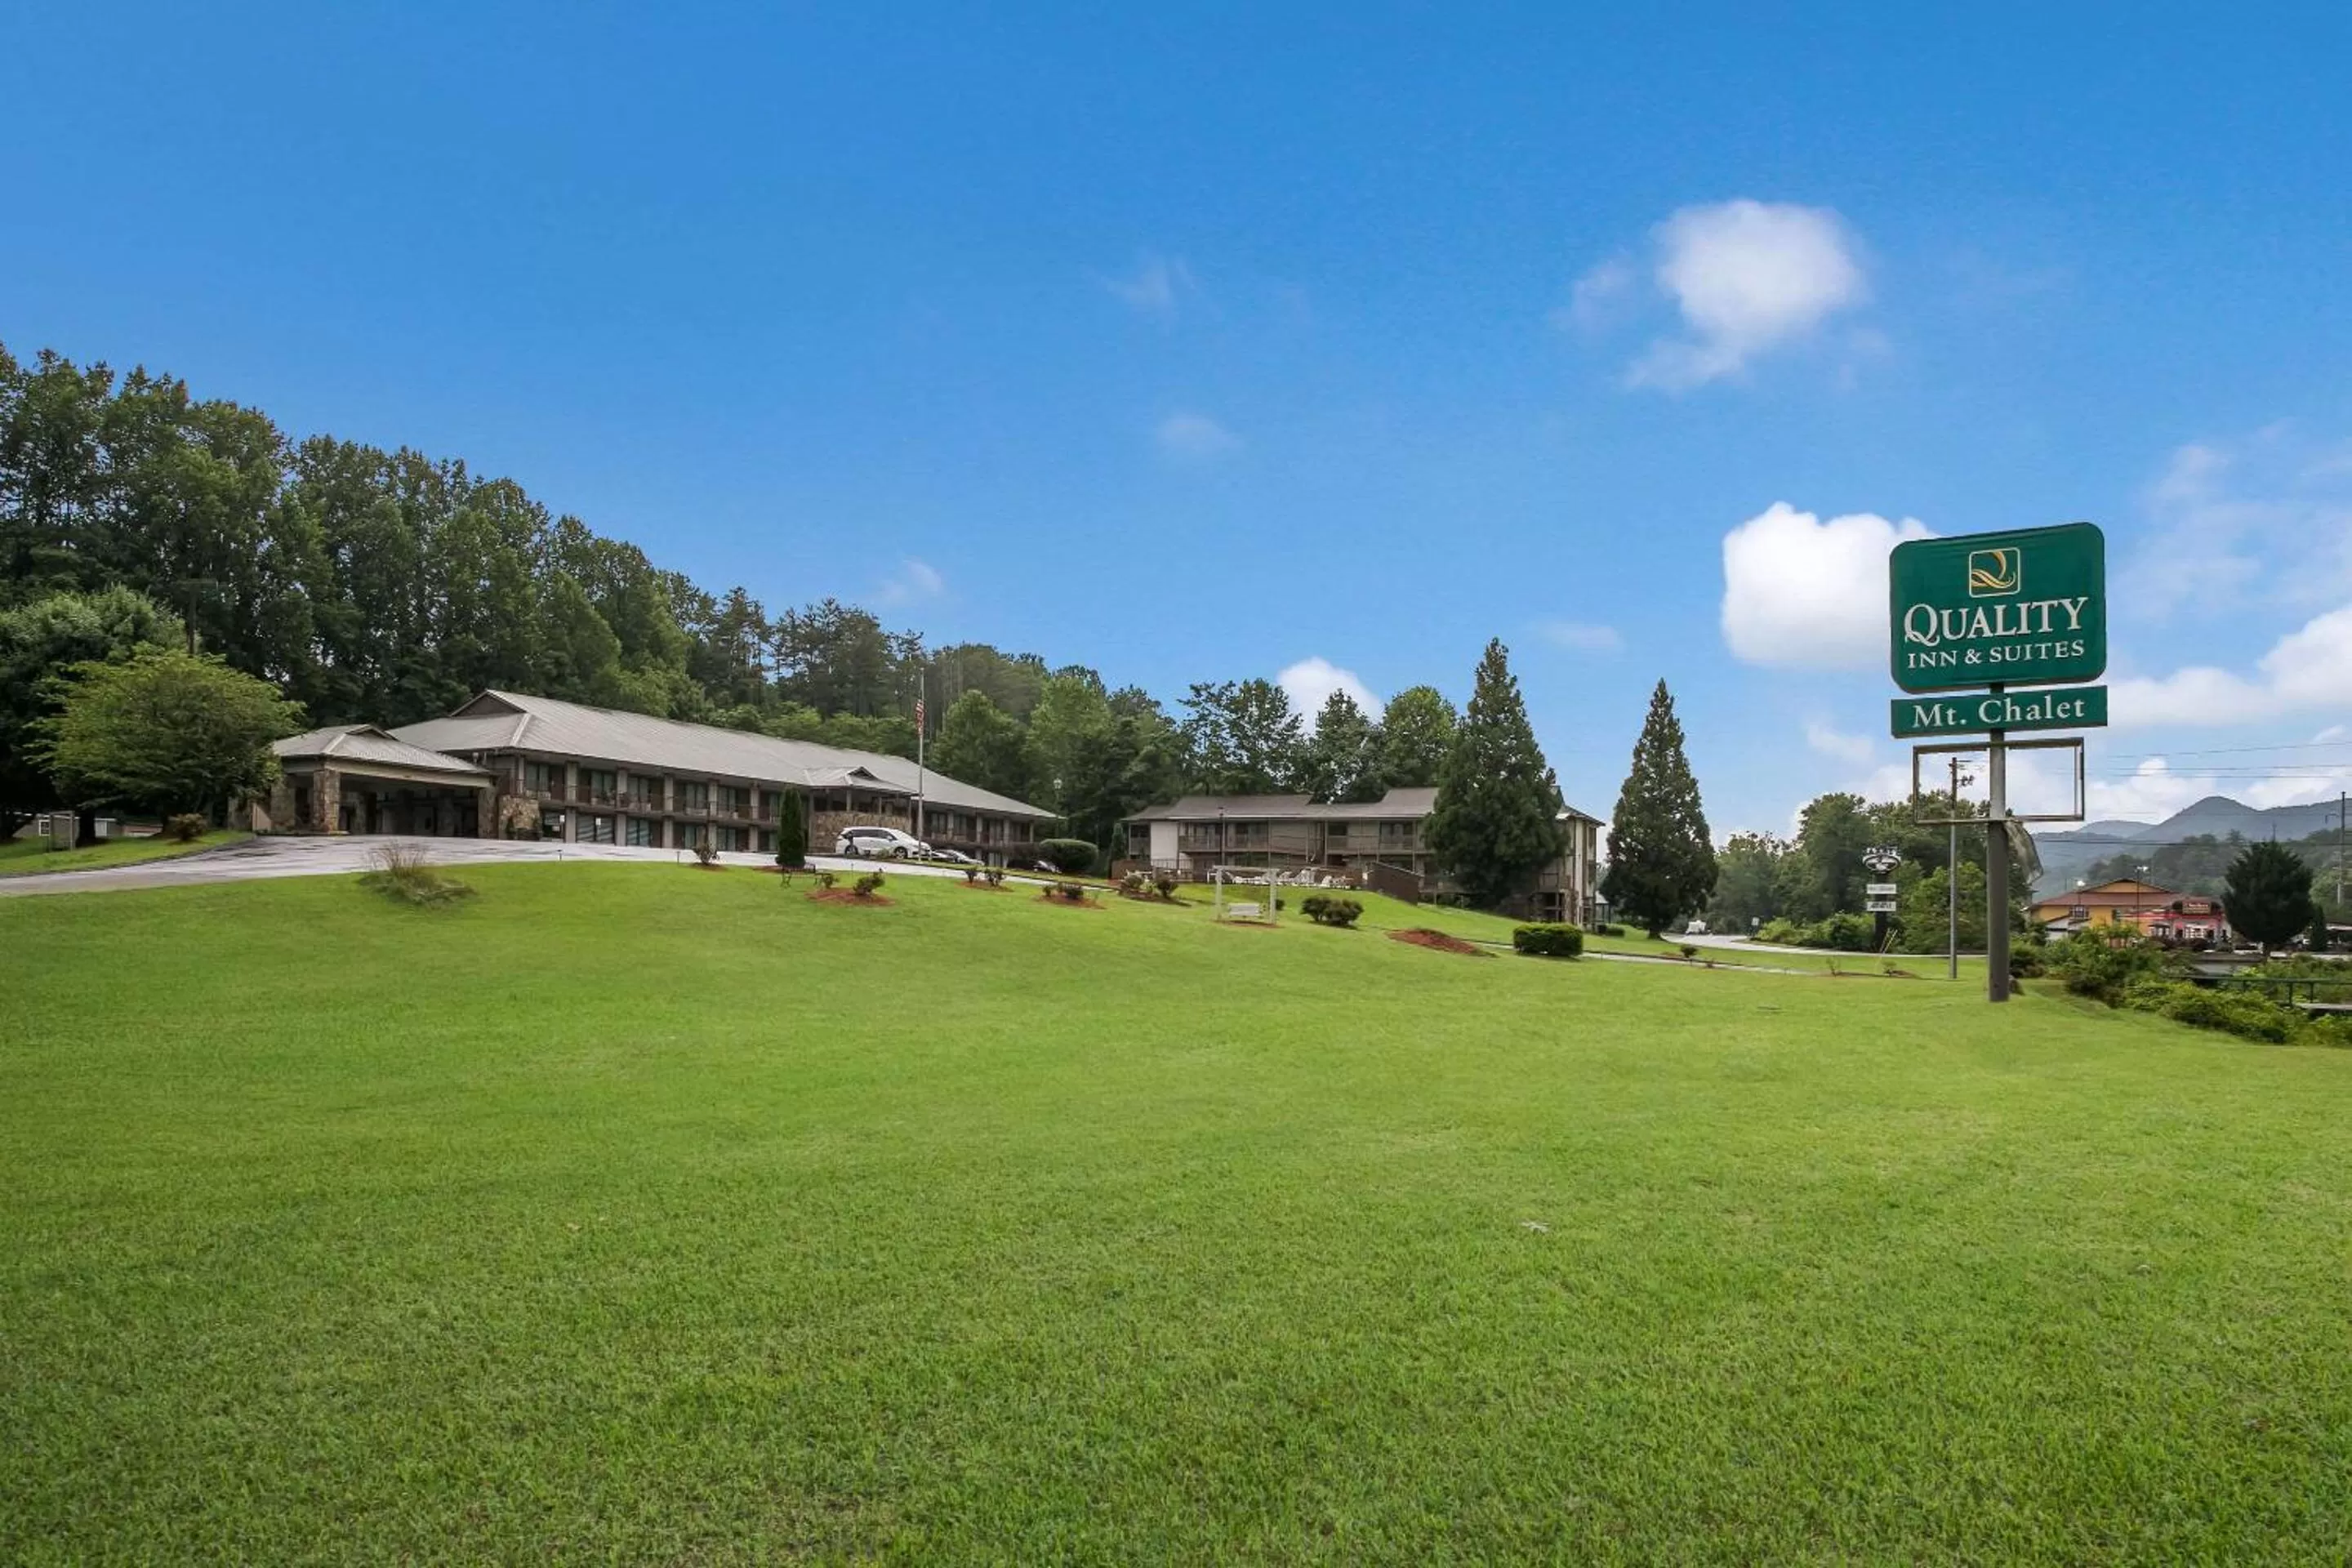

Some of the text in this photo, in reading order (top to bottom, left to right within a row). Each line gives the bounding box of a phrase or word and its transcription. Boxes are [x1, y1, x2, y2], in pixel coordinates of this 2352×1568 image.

[1904, 597, 2088, 647] QUALITY
[1908, 639, 2085, 668] INN & SUITES
[1912, 694, 2085, 728] Mt. Chalet
